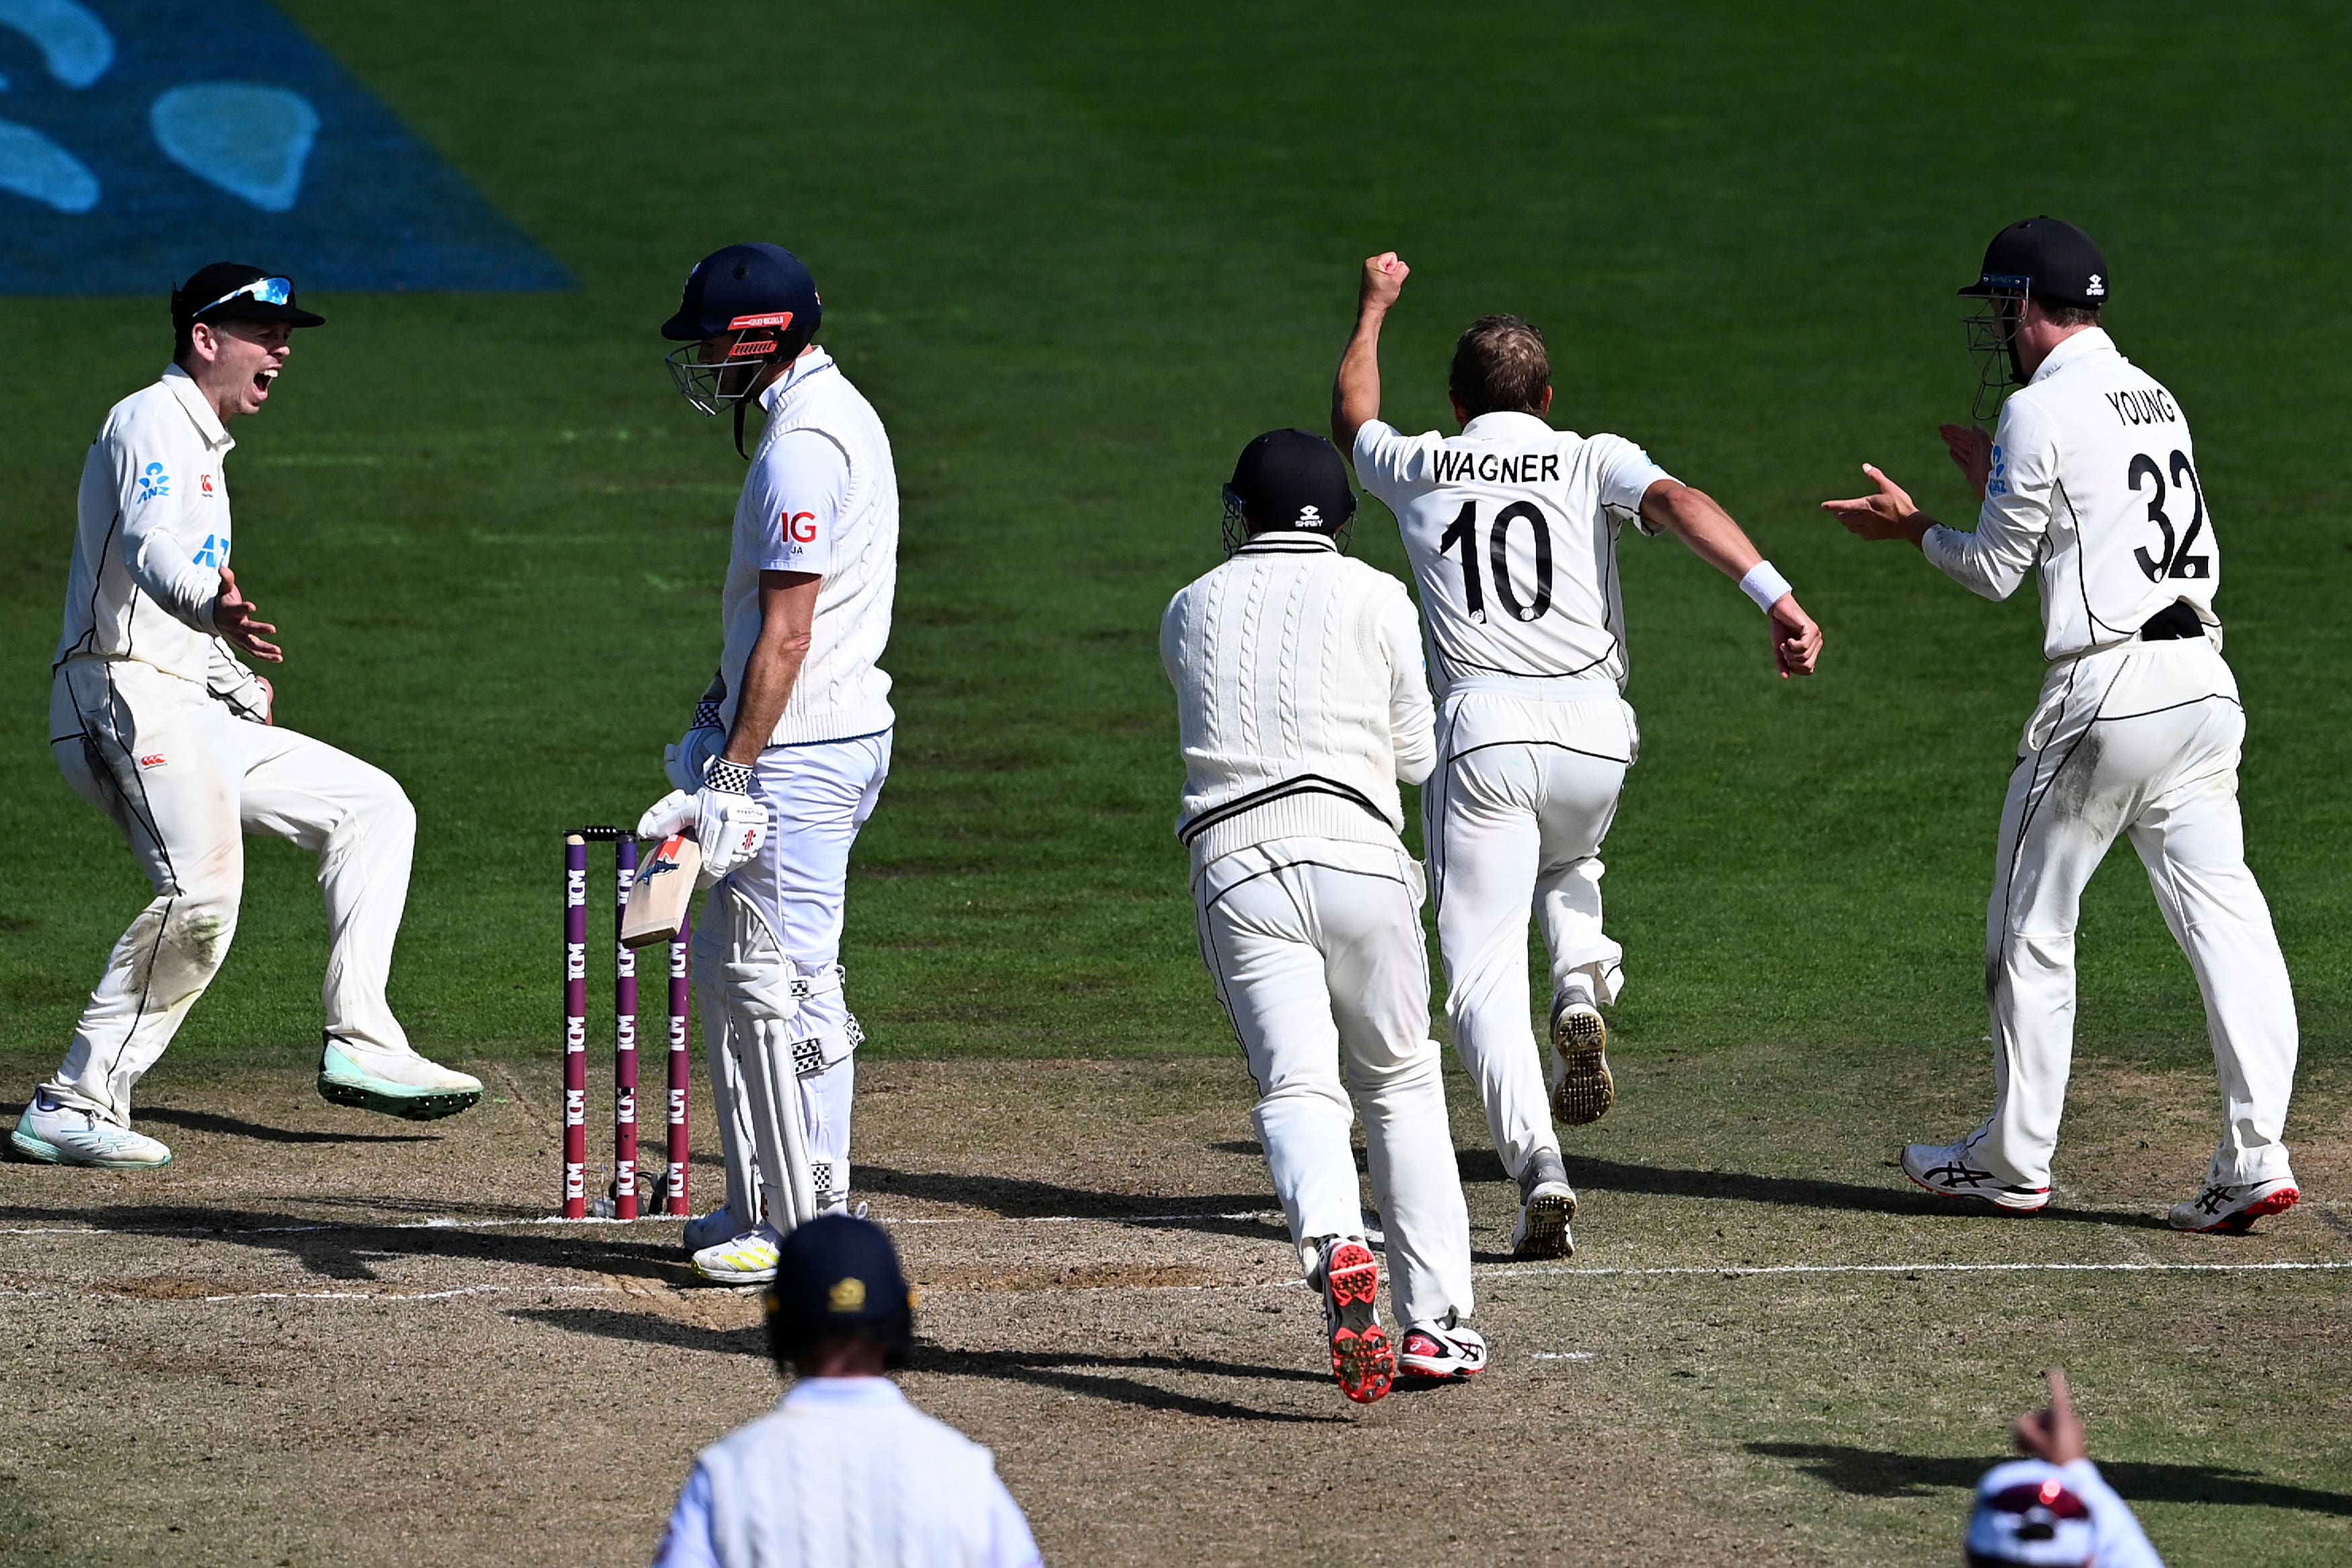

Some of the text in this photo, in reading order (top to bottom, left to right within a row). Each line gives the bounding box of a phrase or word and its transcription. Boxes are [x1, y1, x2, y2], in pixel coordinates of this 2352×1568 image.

[2105, 389, 2174, 426] YOUNG
[1434, 449, 1559, 483] WAGNER
[137, 486, 170, 505] ANZ
[782, 512, 816, 543] IG
[2129, 449, 2209, 583] 32
[791, 546, 803, 554] JA
[1440, 500, 1552, 624] 10
